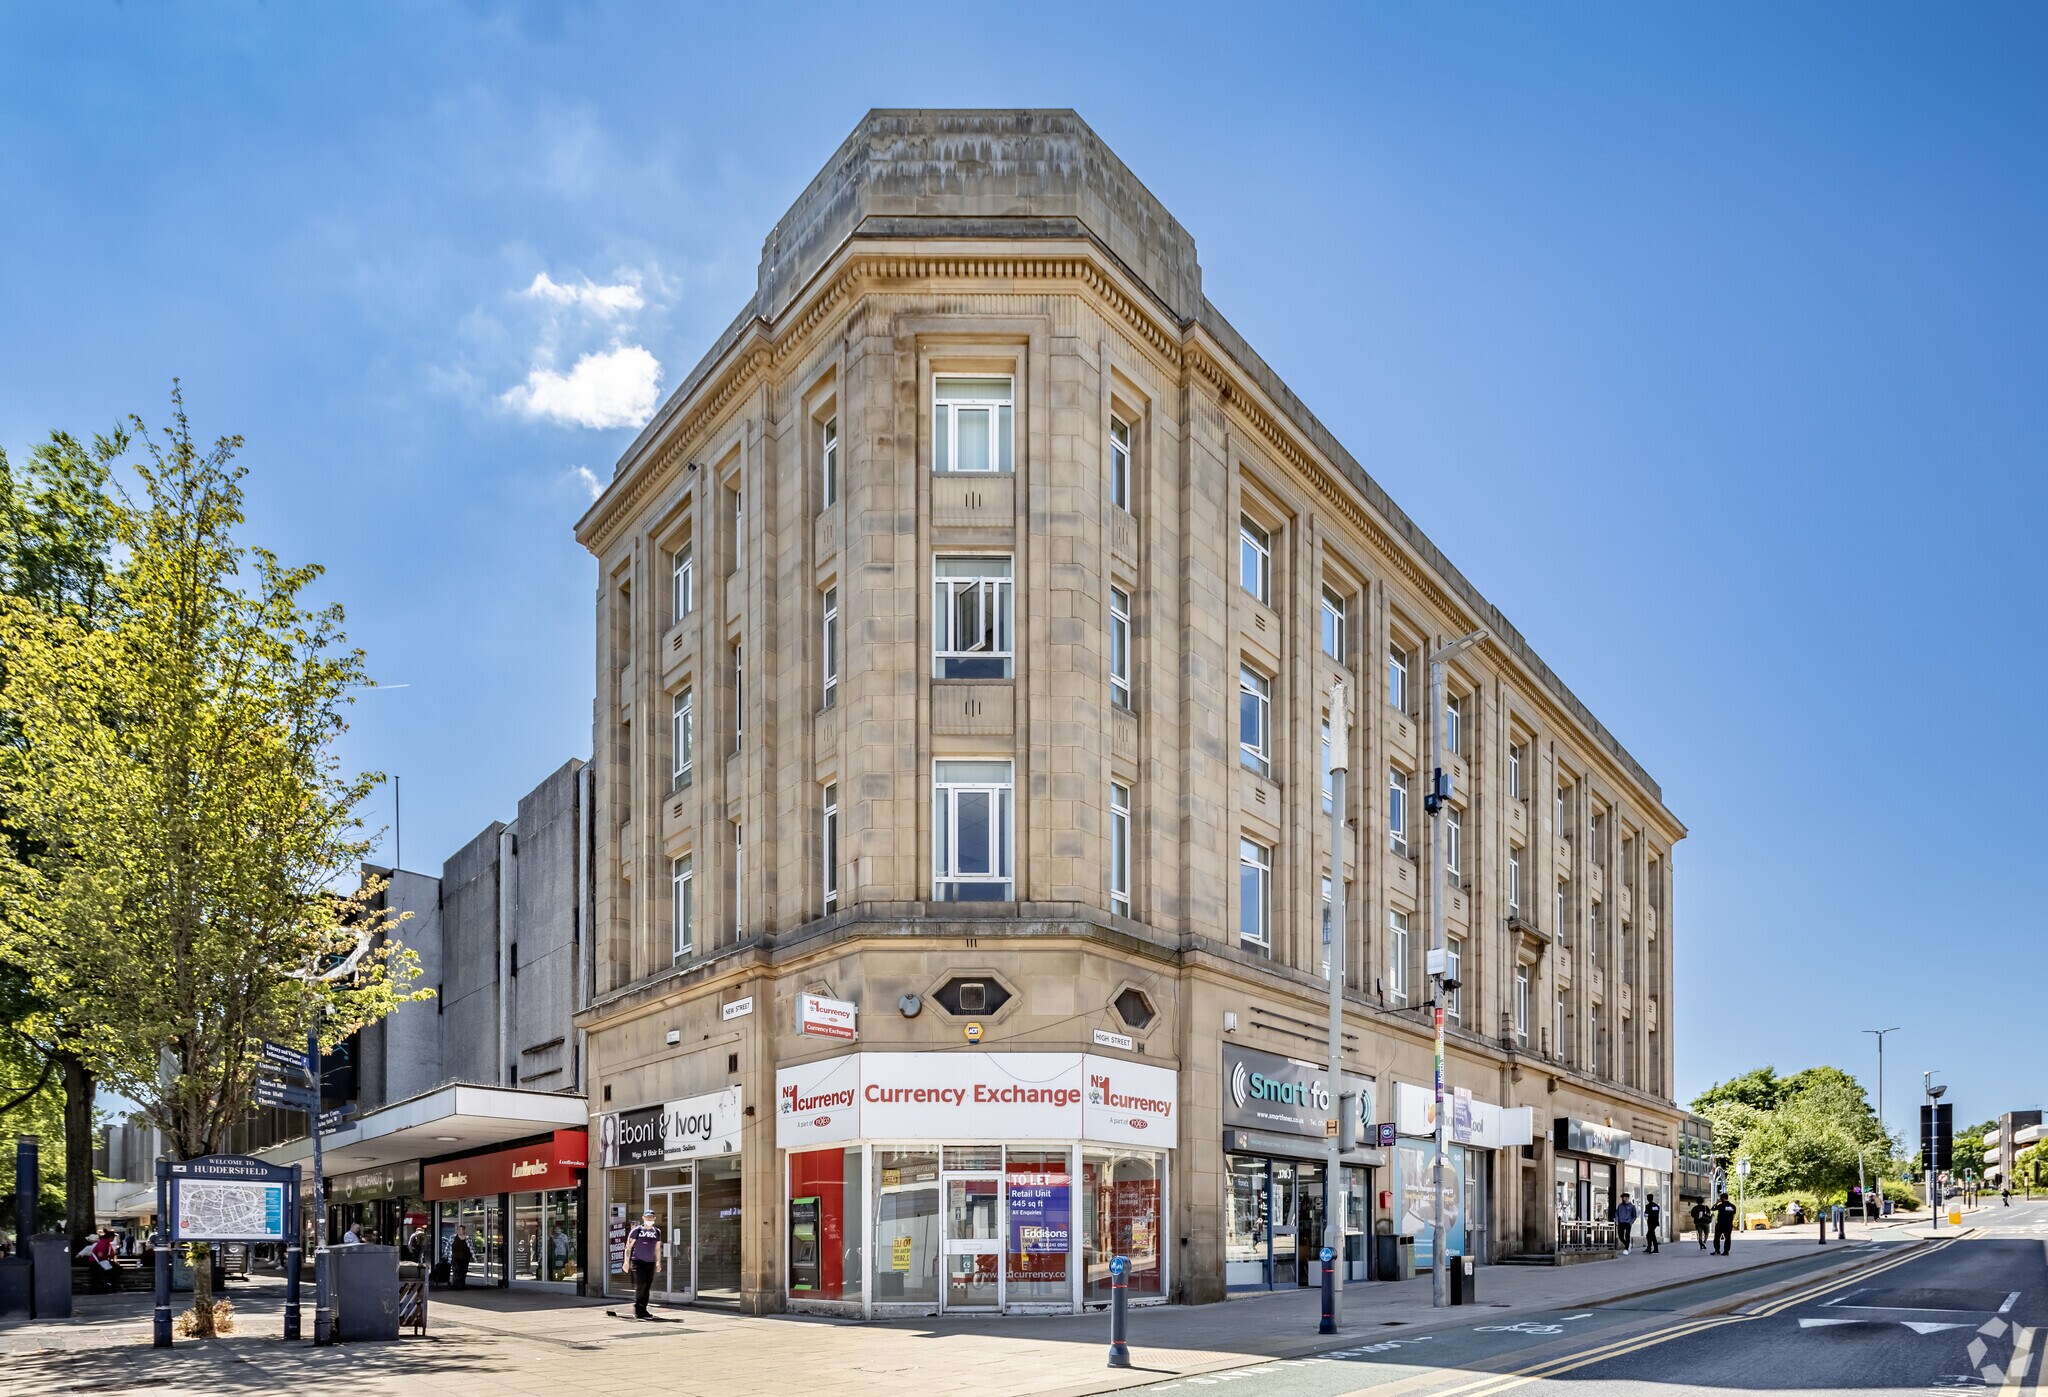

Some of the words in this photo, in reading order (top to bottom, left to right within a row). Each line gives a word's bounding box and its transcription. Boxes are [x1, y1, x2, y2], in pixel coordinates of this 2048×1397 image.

[725, 1007, 735, 1015] NEW
[735, 1002, 750, 1013] STREET
[806, 1024, 829, 1034] Currency
[828, 1027, 852, 1037] Exchange
[1095, 1033, 1110, 1042] HIGH
[1110, 1036, 1130, 1047] STREET
[266, 1043, 281, 1054] Library
[266, 1050, 289, 1062] Information
[259, 1061, 281, 1072] University
[259, 1079, 276, 1088] Market
[1250, 1072, 1307, 1107] Smart
[258, 1088, 271, 1096] Town
[864, 1084, 966, 1107] Currency
[973, 1084, 1081, 1107] Exchange
[257, 1097, 277, 1106] Theatre
[798, 1088, 855, 1111] currency
[1110, 1093, 1172, 1117] currency
[800, 1120, 809, 1128] part
[1113, 1117, 1123, 1125] part
[1326, 1120, 1338, 1134] H
[620, 1118, 656, 1145] Eboni
[659, 1112, 671, 1140] &
[675, 1111, 712, 1141] Ivory
[632, 1151, 642, 1160] Wigs
[682, 1144, 696, 1152] Salon
[208, 1158, 243, 1166] WELCOME
[194, 1165, 268, 1175] HUDDERSFIELD
[511, 1159, 548, 1178] Ladbrokes
[440, 1172, 467, 1188] Ladbrokes
[1011, 1174, 1026, 1186] TO
[1030, 1174, 1051, 1186] LET
[1035, 1189, 1051, 1197] Unit
[609, 1228, 626, 1239] MOVING
[1024, 1228, 1068, 1238] Eddisons
[611, 1251, 624, 1261] STORE
